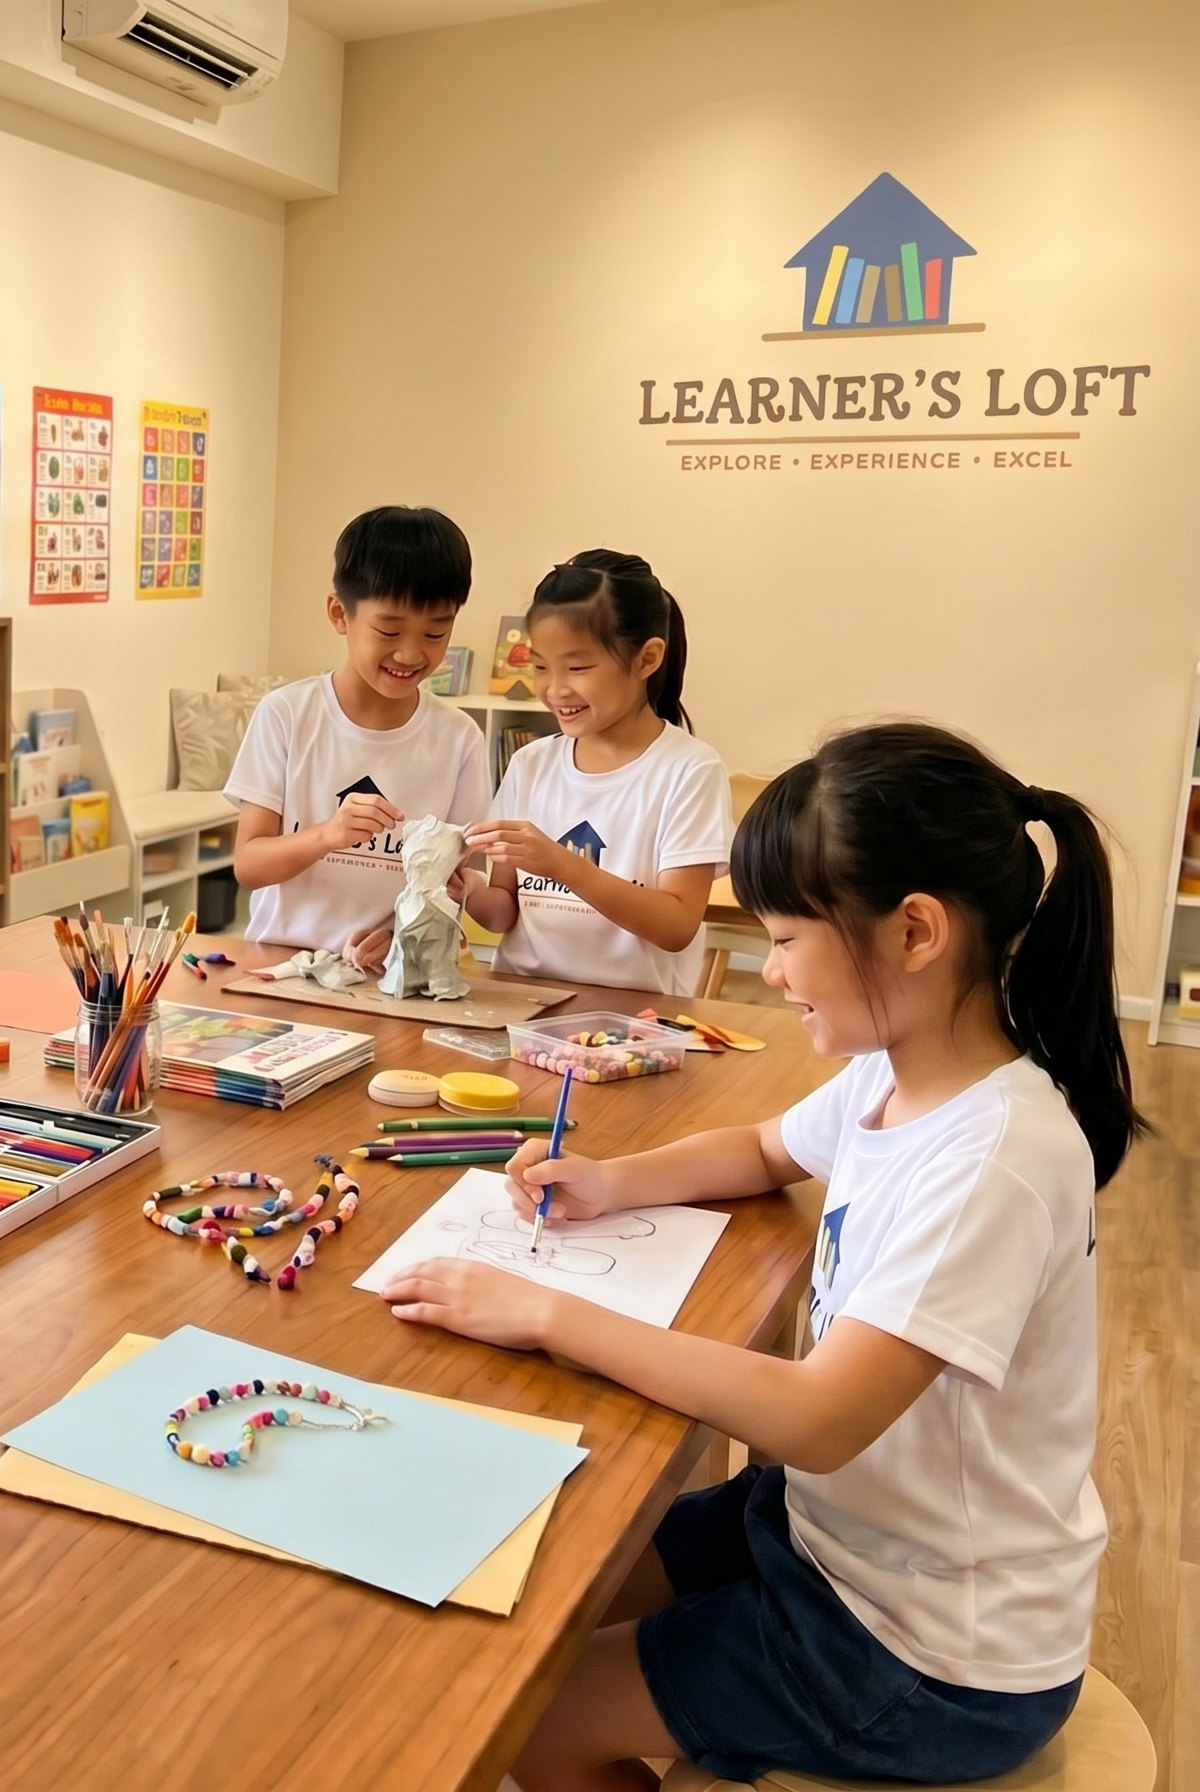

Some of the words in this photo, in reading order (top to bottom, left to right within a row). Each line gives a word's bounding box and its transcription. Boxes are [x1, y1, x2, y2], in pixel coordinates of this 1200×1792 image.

[638, 369, 962, 426] LEARNER'S
[984, 364, 1151, 417] LOFT
[680, 454, 782, 471] EXPLORE
[809, 452, 961, 470] EXPERIENCE
[993, 450, 1072, 468] EXCEL
